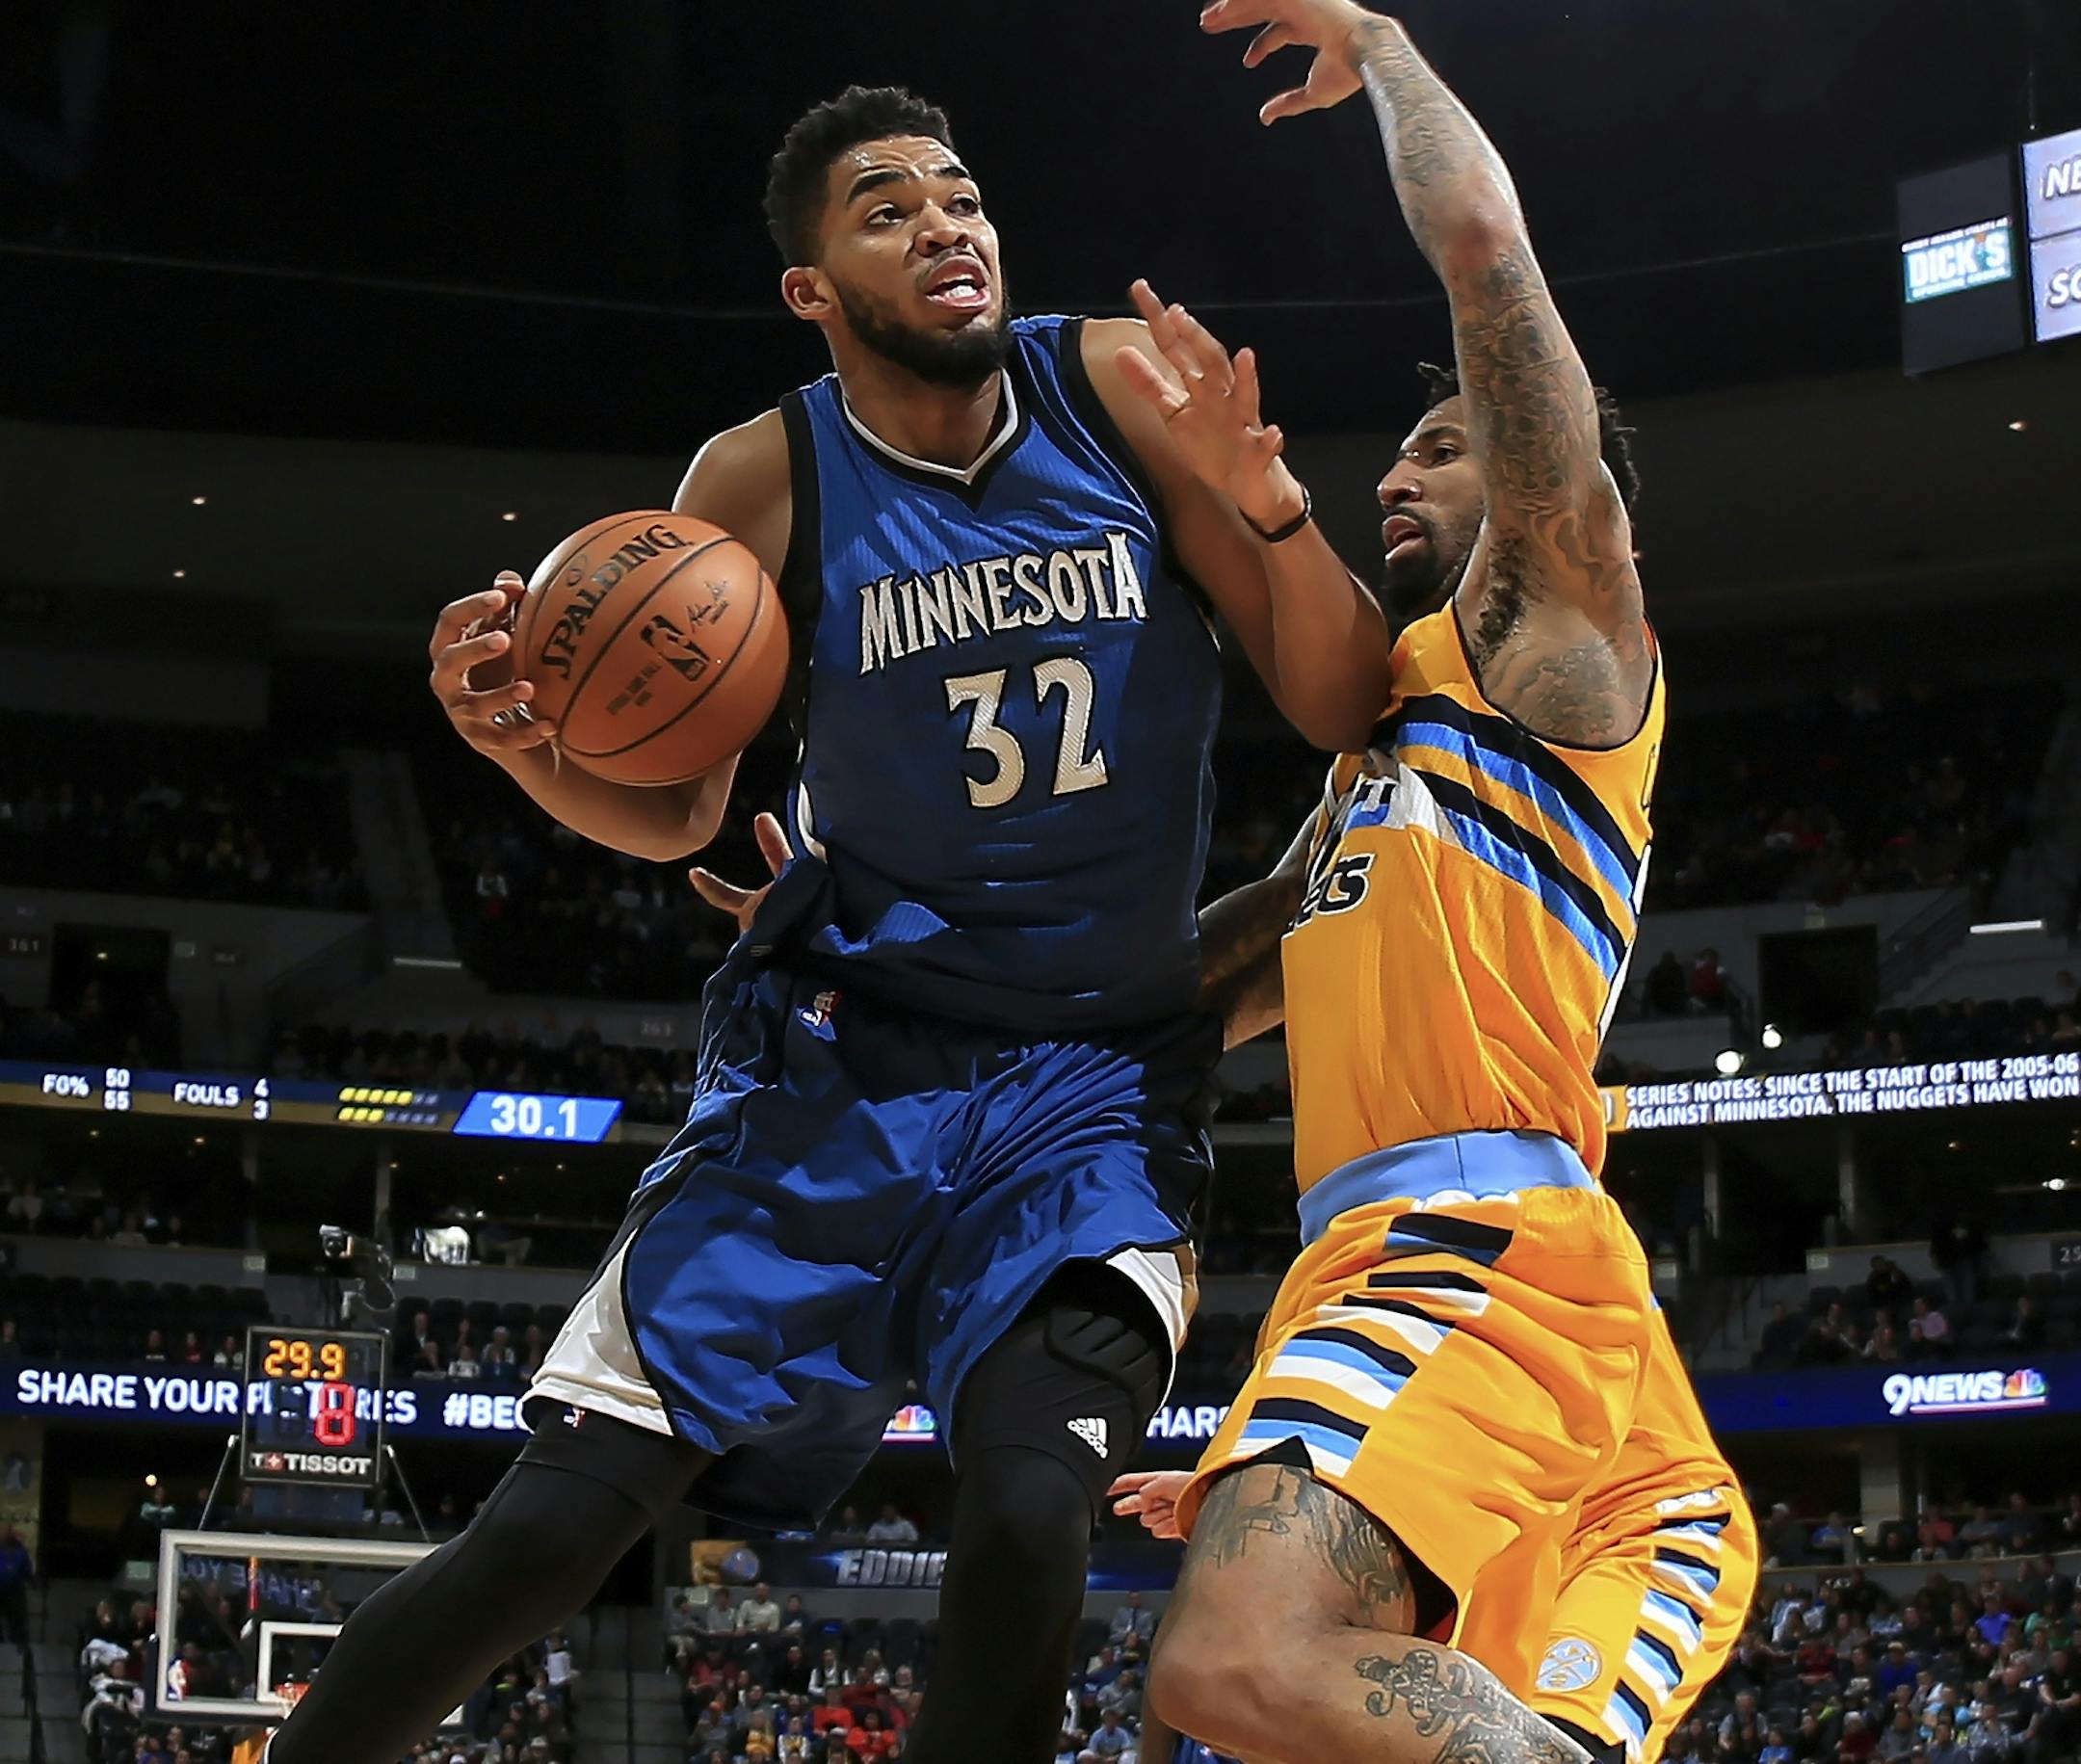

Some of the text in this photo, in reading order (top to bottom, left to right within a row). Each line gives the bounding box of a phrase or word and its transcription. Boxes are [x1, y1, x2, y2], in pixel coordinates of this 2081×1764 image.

[1908, 232, 2006, 287] DICK'S
[540, 524, 695, 680] SPALDING
[858, 532, 1149, 674] MINNESOTA
[944, 657, 1108, 807] 32
[105, 1067, 130, 1088] 50
[173, 1082, 240, 1107] FOULS
[1625, 1052, 2080, 1107] SERIES NOTES: SINCE THE START OF THE 2005-06
[104, 1090, 130, 1111] 55
[253, 1100, 269, 1120] 3
[490, 1095, 578, 1138] 30.1
[1625, 1104, 1710, 1129] AGAINST
[1836, 1091, 1874, 1114] THE
[1876, 1084, 1968, 1110] NUGGETS
[1973, 1080, 2027, 1103] HAVE
[2029, 1076, 2080, 1098] WON
[264, 1339, 346, 1379] 29.9
[17, 1369, 137, 1409] SHARE
[144, 1376, 240, 1414] YOUR
[1883, 1370, 2006, 1416] 9NEWS
[314, 1382, 356, 1447] 8
[1146, 1406, 1230, 1437] HAR
[283, 1453, 371, 1475] TISSOT
